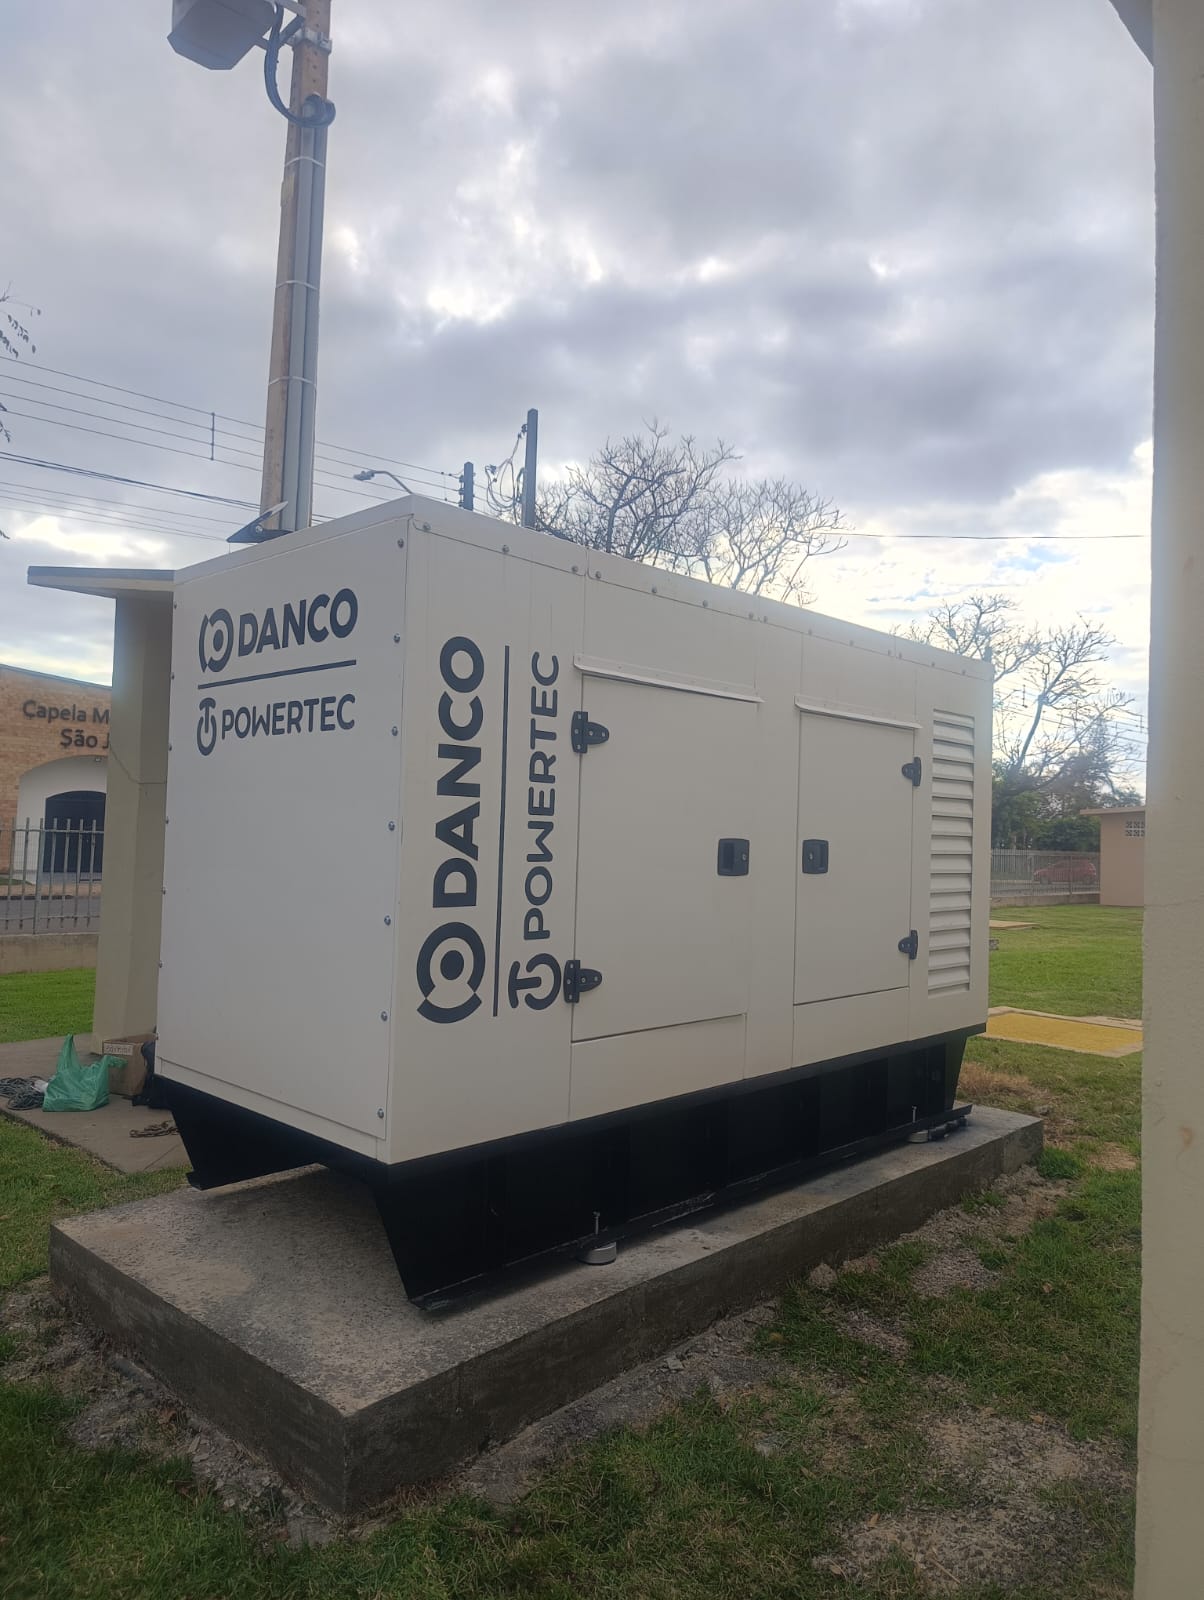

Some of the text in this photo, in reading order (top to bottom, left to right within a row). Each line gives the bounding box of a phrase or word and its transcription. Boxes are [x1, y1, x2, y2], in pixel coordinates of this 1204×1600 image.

[237, 587, 359, 657] DANCO
[23, 699, 110, 724] Capela M
[60, 728, 98, 749] São
[221, 693, 356, 740] POWERTEC
[432, 636, 485, 908] DANCO
[523, 651, 560, 941] POWERTEC
